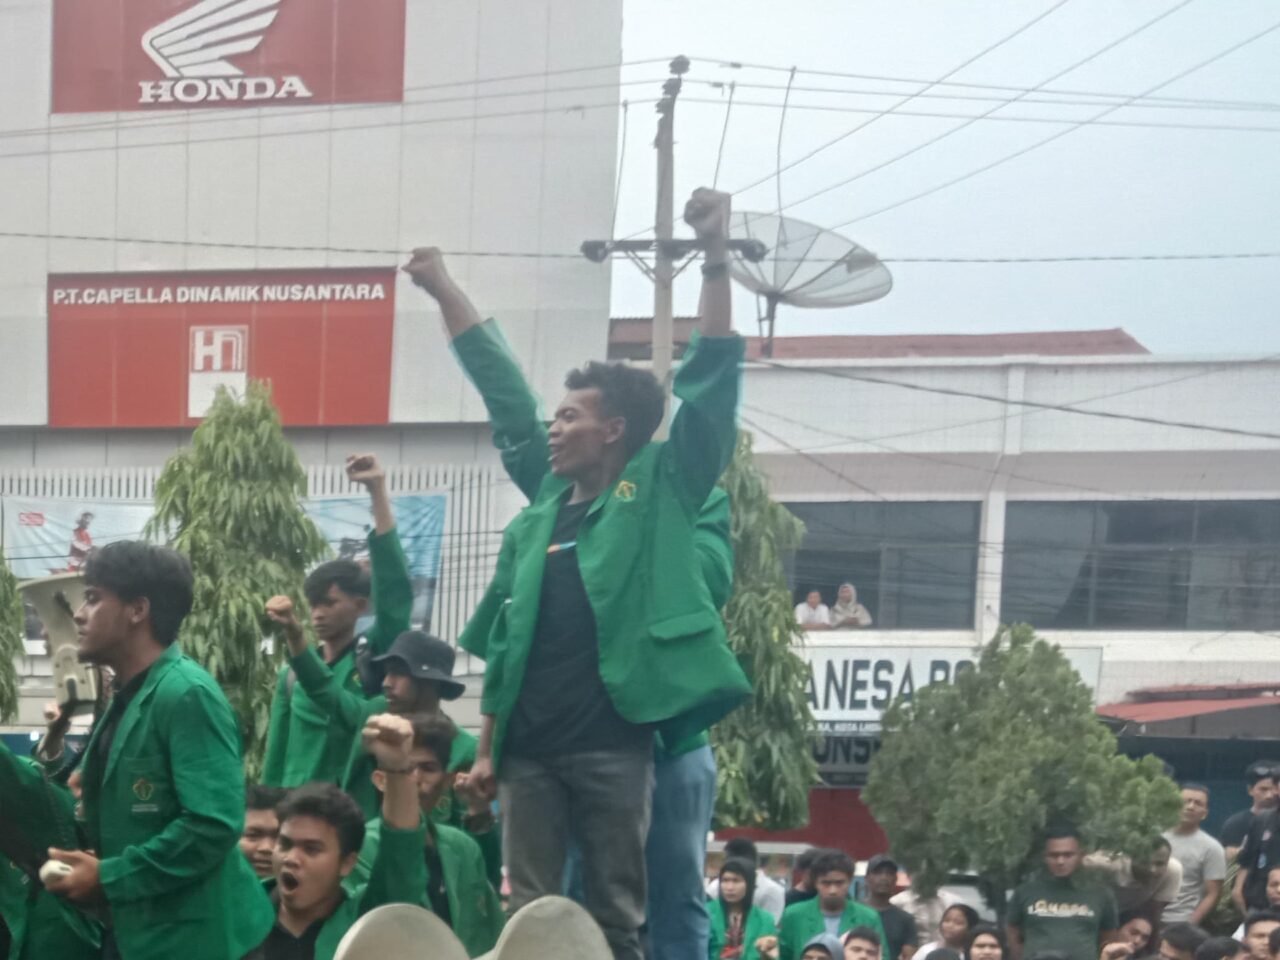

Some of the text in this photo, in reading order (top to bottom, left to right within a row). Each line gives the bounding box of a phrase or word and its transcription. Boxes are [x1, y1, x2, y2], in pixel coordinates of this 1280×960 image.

[138, 75, 313, 103] HONDA
[176, 286, 260, 303] DINAMIK
[262, 284, 385, 302] NUSANTARA
